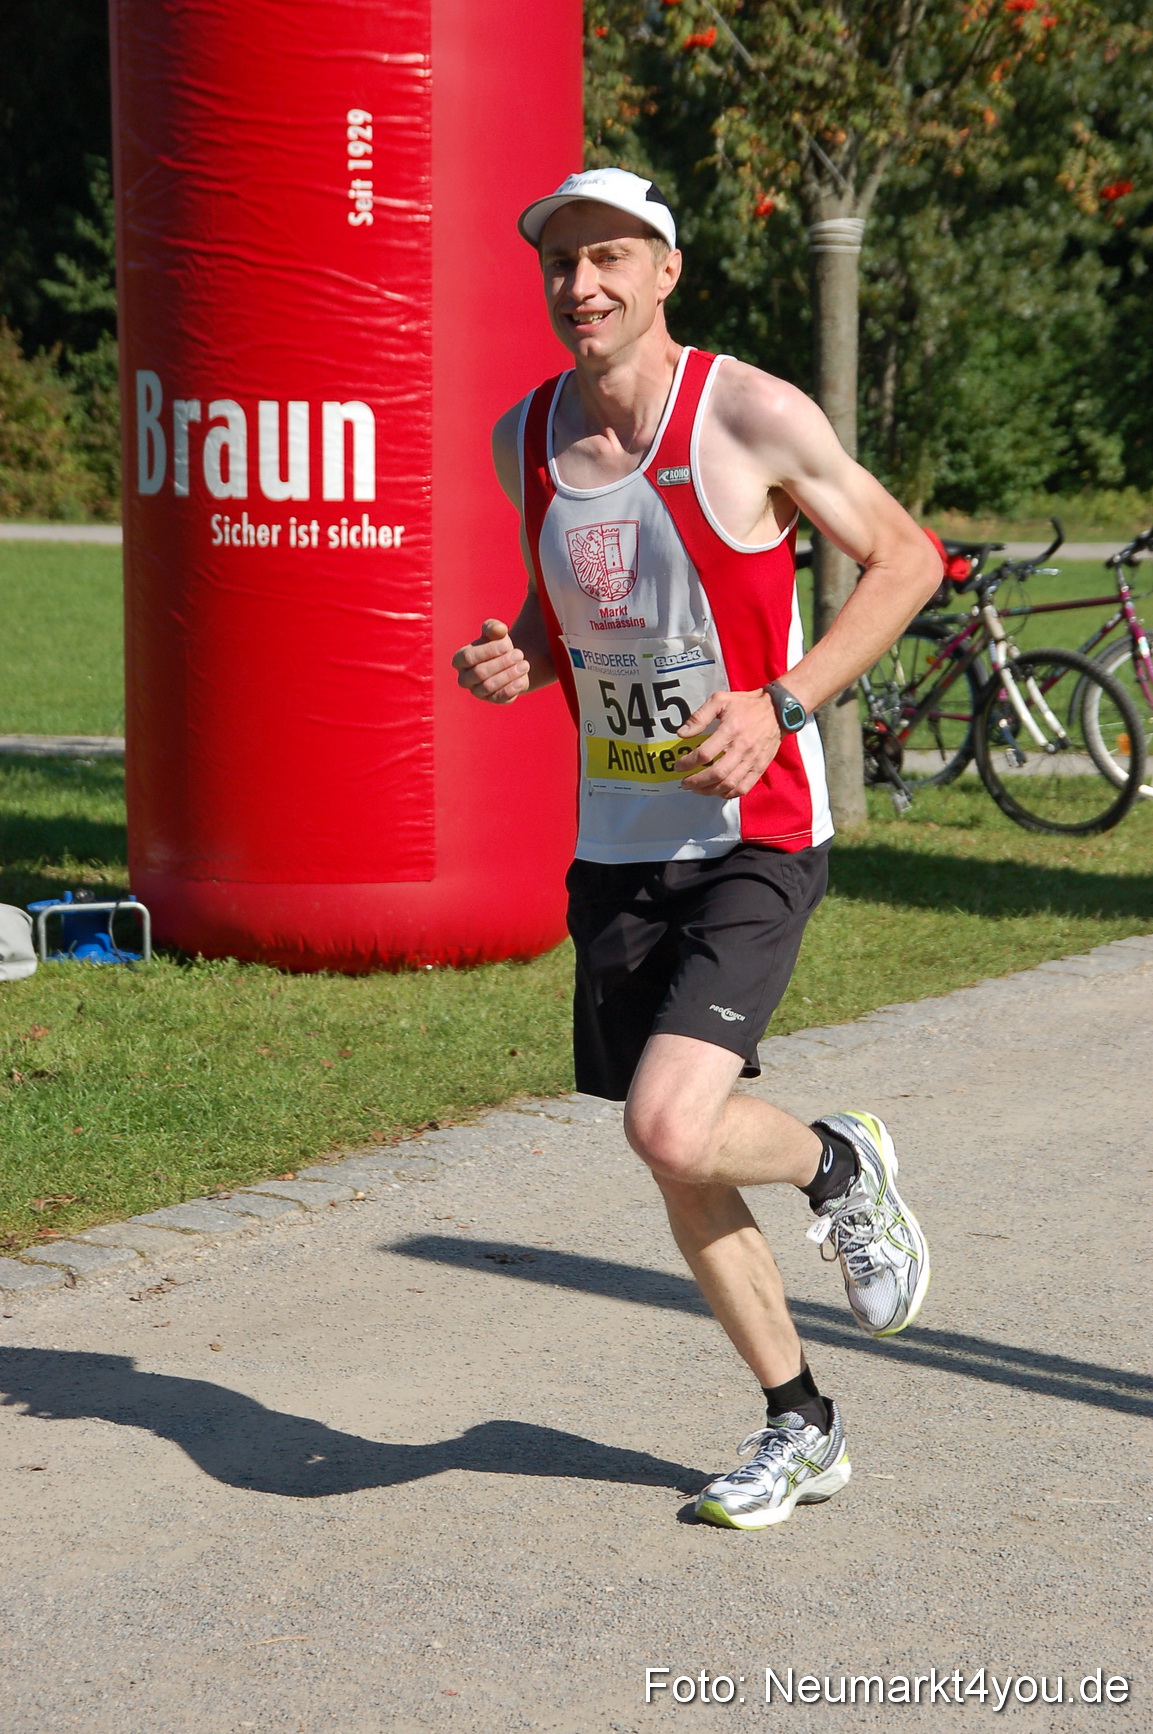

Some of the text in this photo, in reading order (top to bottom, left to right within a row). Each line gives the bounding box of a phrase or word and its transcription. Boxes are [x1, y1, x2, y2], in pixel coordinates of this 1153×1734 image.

[347, 108, 374, 226] Seit 1929
[135, 369, 376, 502] Braun
[211, 512, 405, 549] Sicher ist sicher
[589, 616, 646, 630] Thalmässing
[599, 605, 628, 618] Markt
[582, 650, 638, 667] PFLEIDERER
[599, 679, 692, 738] 545
[586, 721, 594, 734] C
[608, 740, 713, 775] Andre
